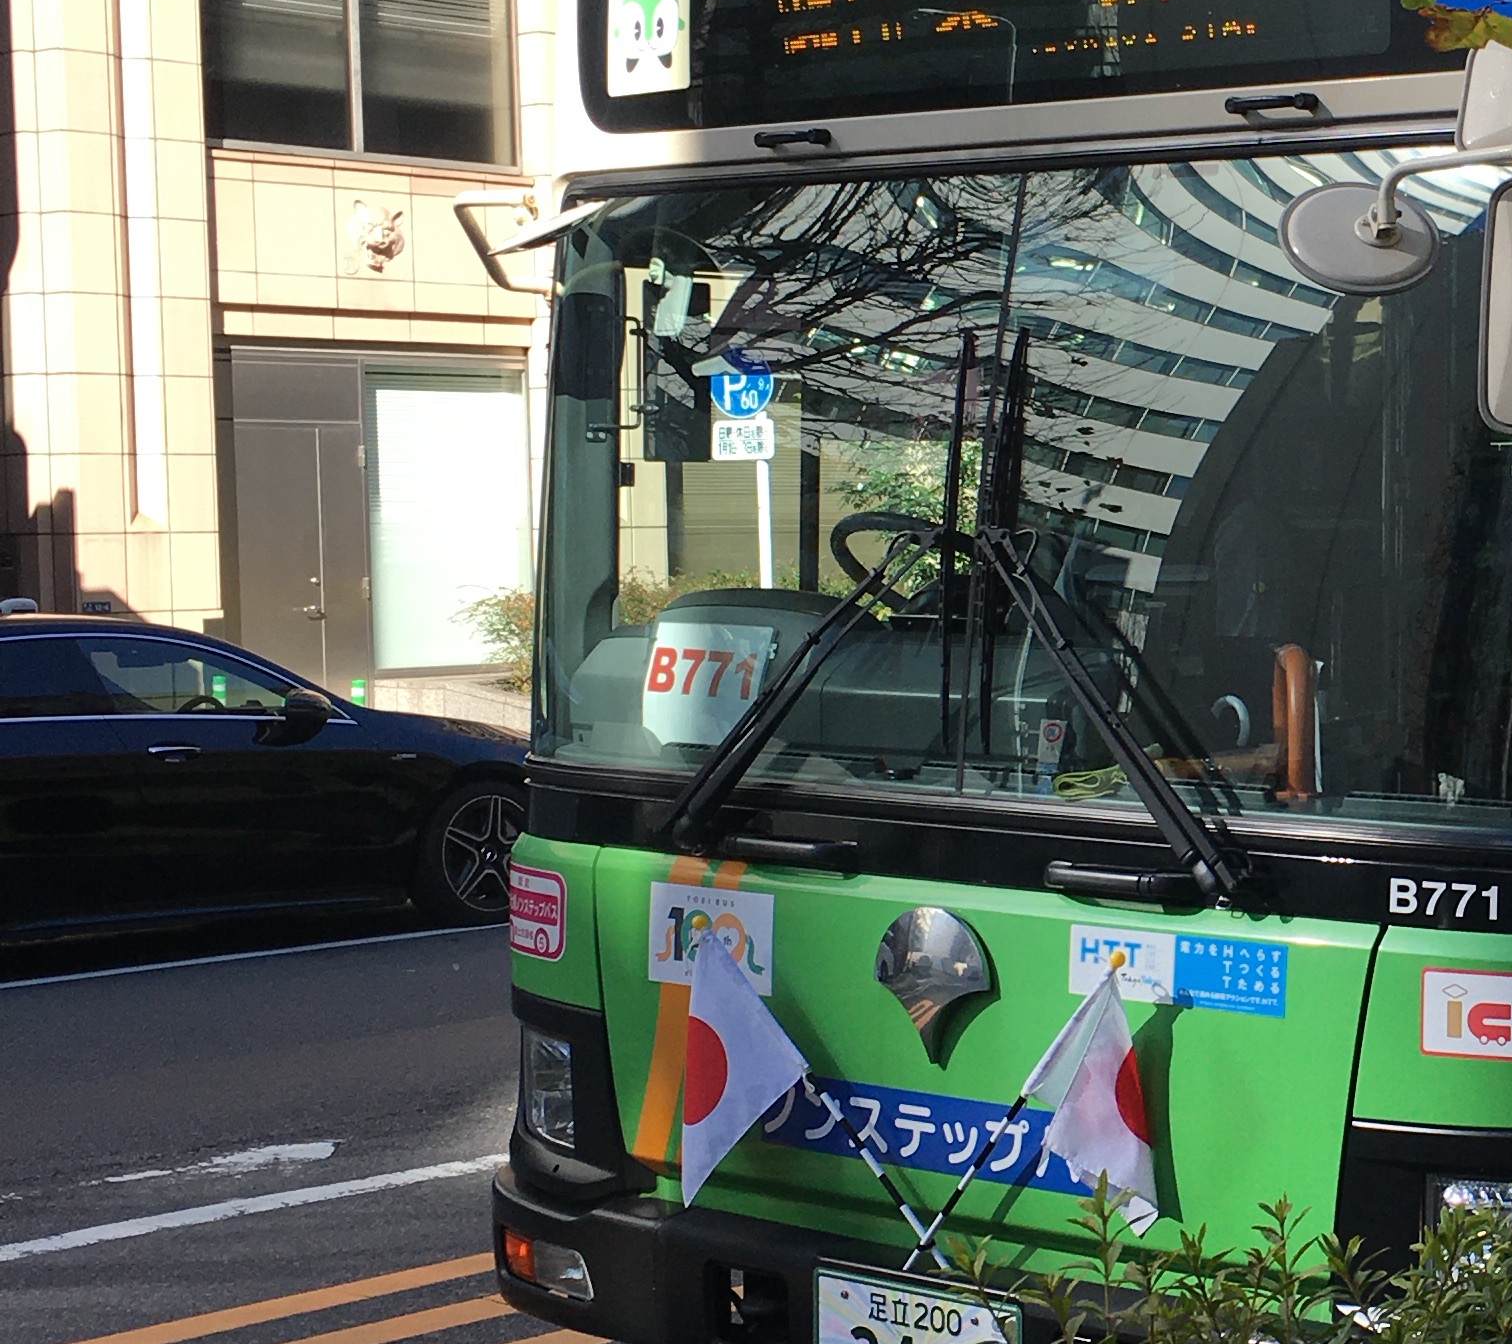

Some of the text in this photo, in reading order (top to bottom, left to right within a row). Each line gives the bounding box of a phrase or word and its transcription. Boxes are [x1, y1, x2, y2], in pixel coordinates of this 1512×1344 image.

[740, 389, 759, 410] 60
[647, 646, 758, 701] B771
[1388, 876, 1499, 921] B771
[867, 1291, 963, 1337] 足立200
